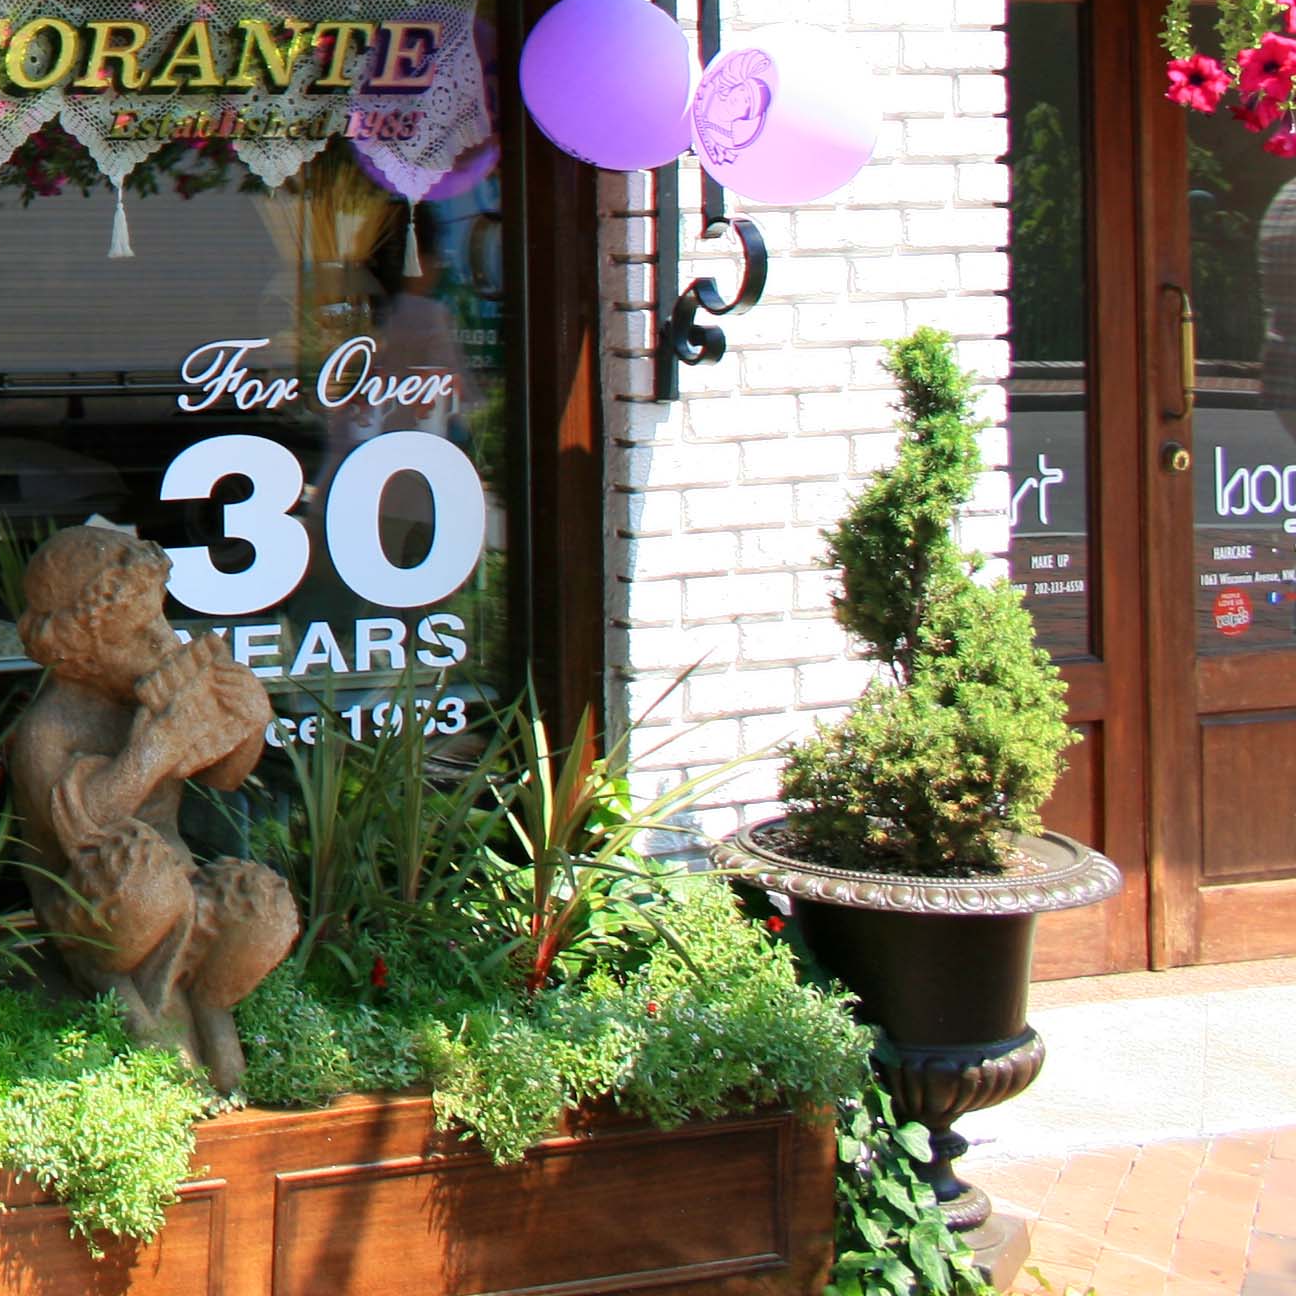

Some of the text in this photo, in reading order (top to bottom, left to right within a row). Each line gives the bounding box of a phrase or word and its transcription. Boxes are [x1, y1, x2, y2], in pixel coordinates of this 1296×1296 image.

[106, 108, 425, 141] Established 1983
[177, 336, 453, 412] For Over
[159, 430, 486, 615] 30
[1031, 554, 1070, 569] MAKE UP
[1213, 545, 1252, 560] HAIRCARE
